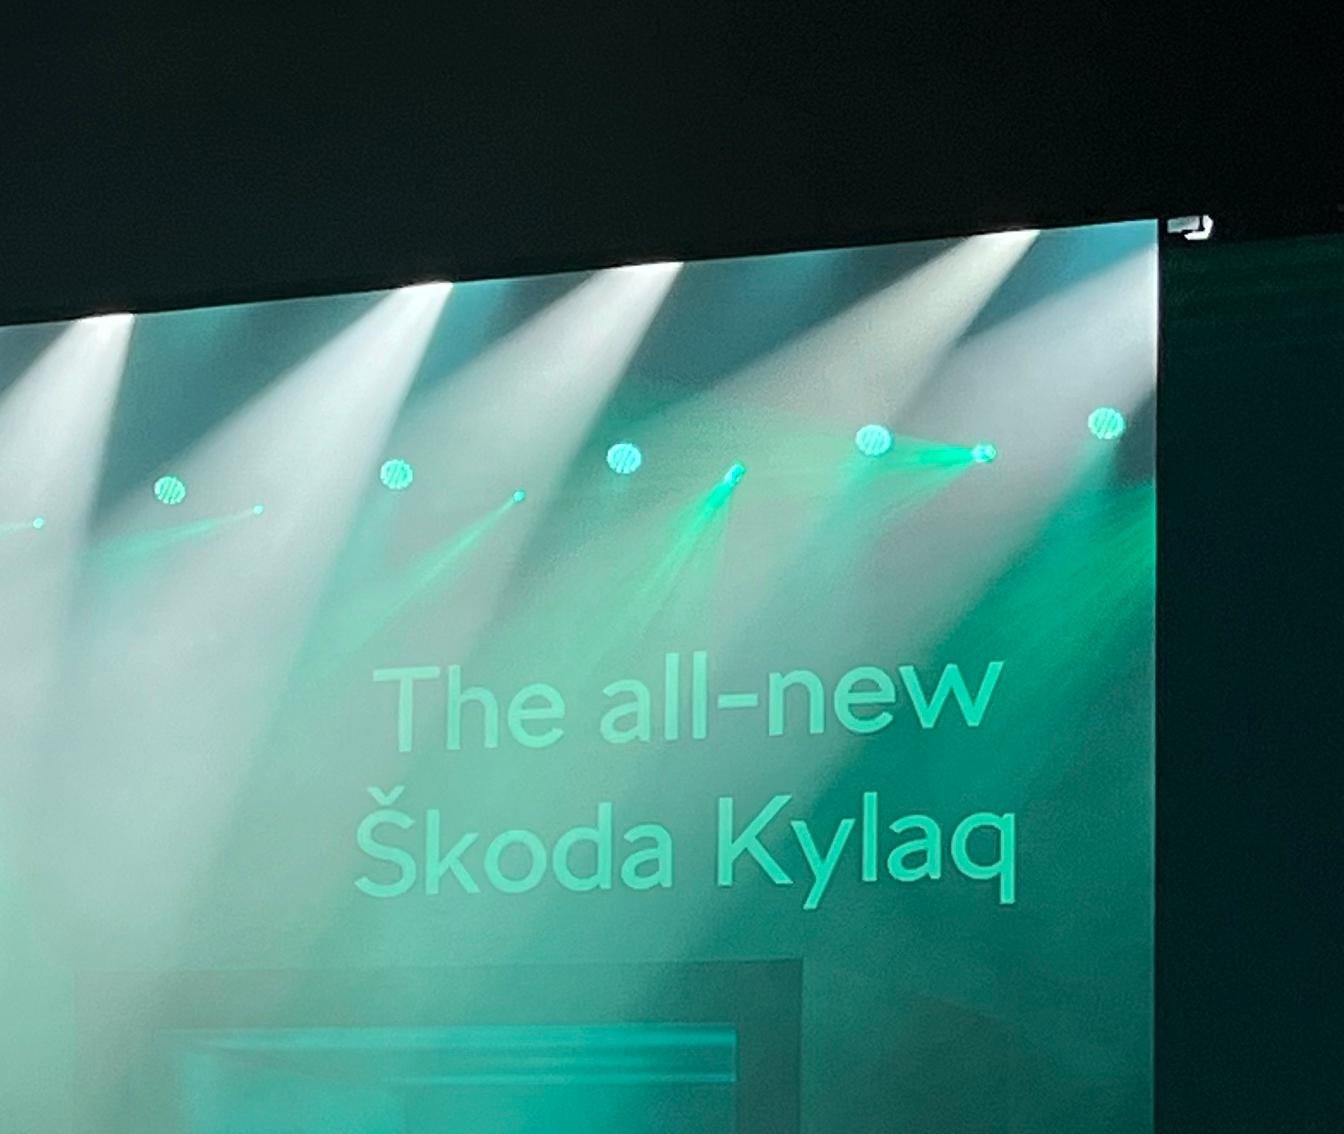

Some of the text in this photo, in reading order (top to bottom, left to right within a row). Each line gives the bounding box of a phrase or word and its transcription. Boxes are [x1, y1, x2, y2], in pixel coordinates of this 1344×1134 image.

[373, 650, 1006, 752] The all-new
[355, 785, 1018, 911] Škoda Kylaq
